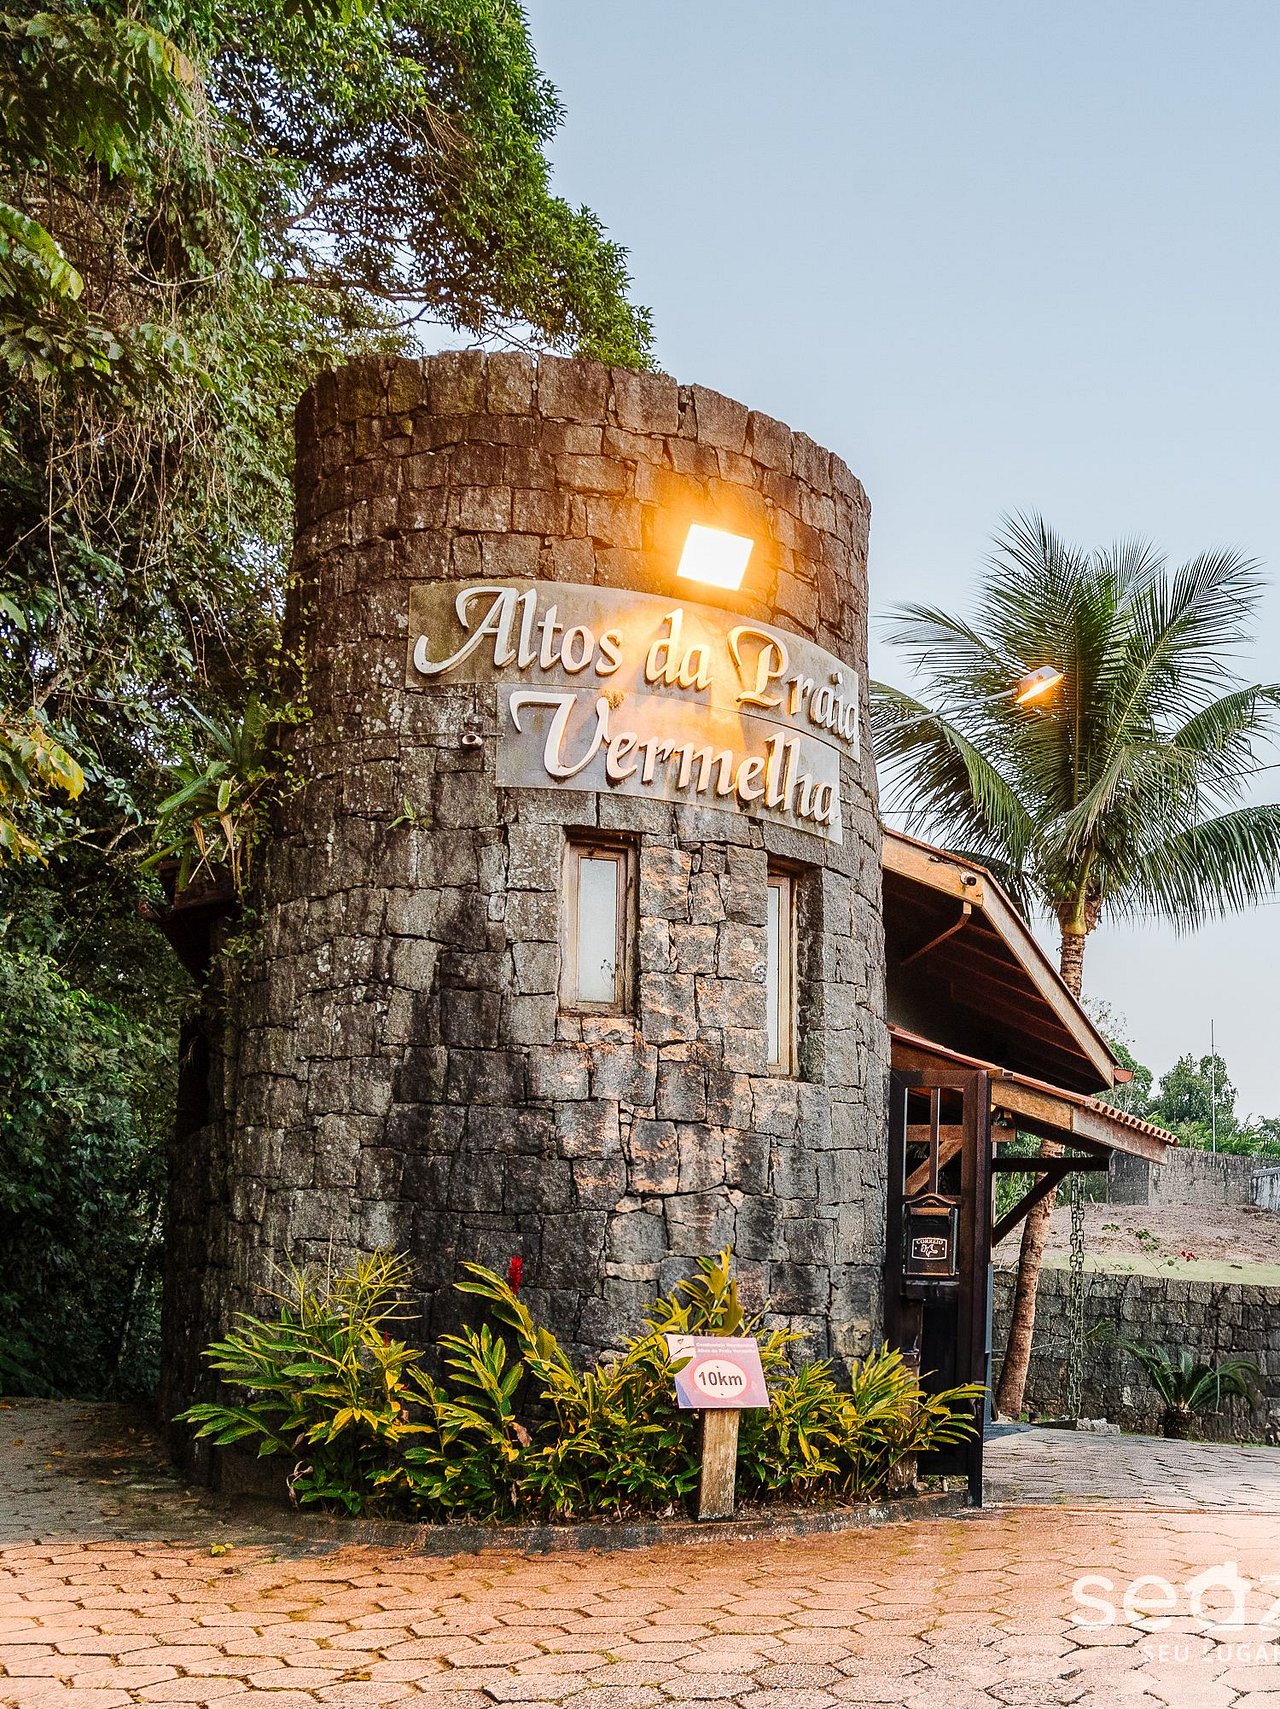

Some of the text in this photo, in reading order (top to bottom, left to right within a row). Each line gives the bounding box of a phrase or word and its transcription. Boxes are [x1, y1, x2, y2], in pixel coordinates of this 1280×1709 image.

[412, 585, 861, 744] Altos da Praia
[509, 690, 842, 826] Vermelha
[698, 1371, 743, 1386] 10km
